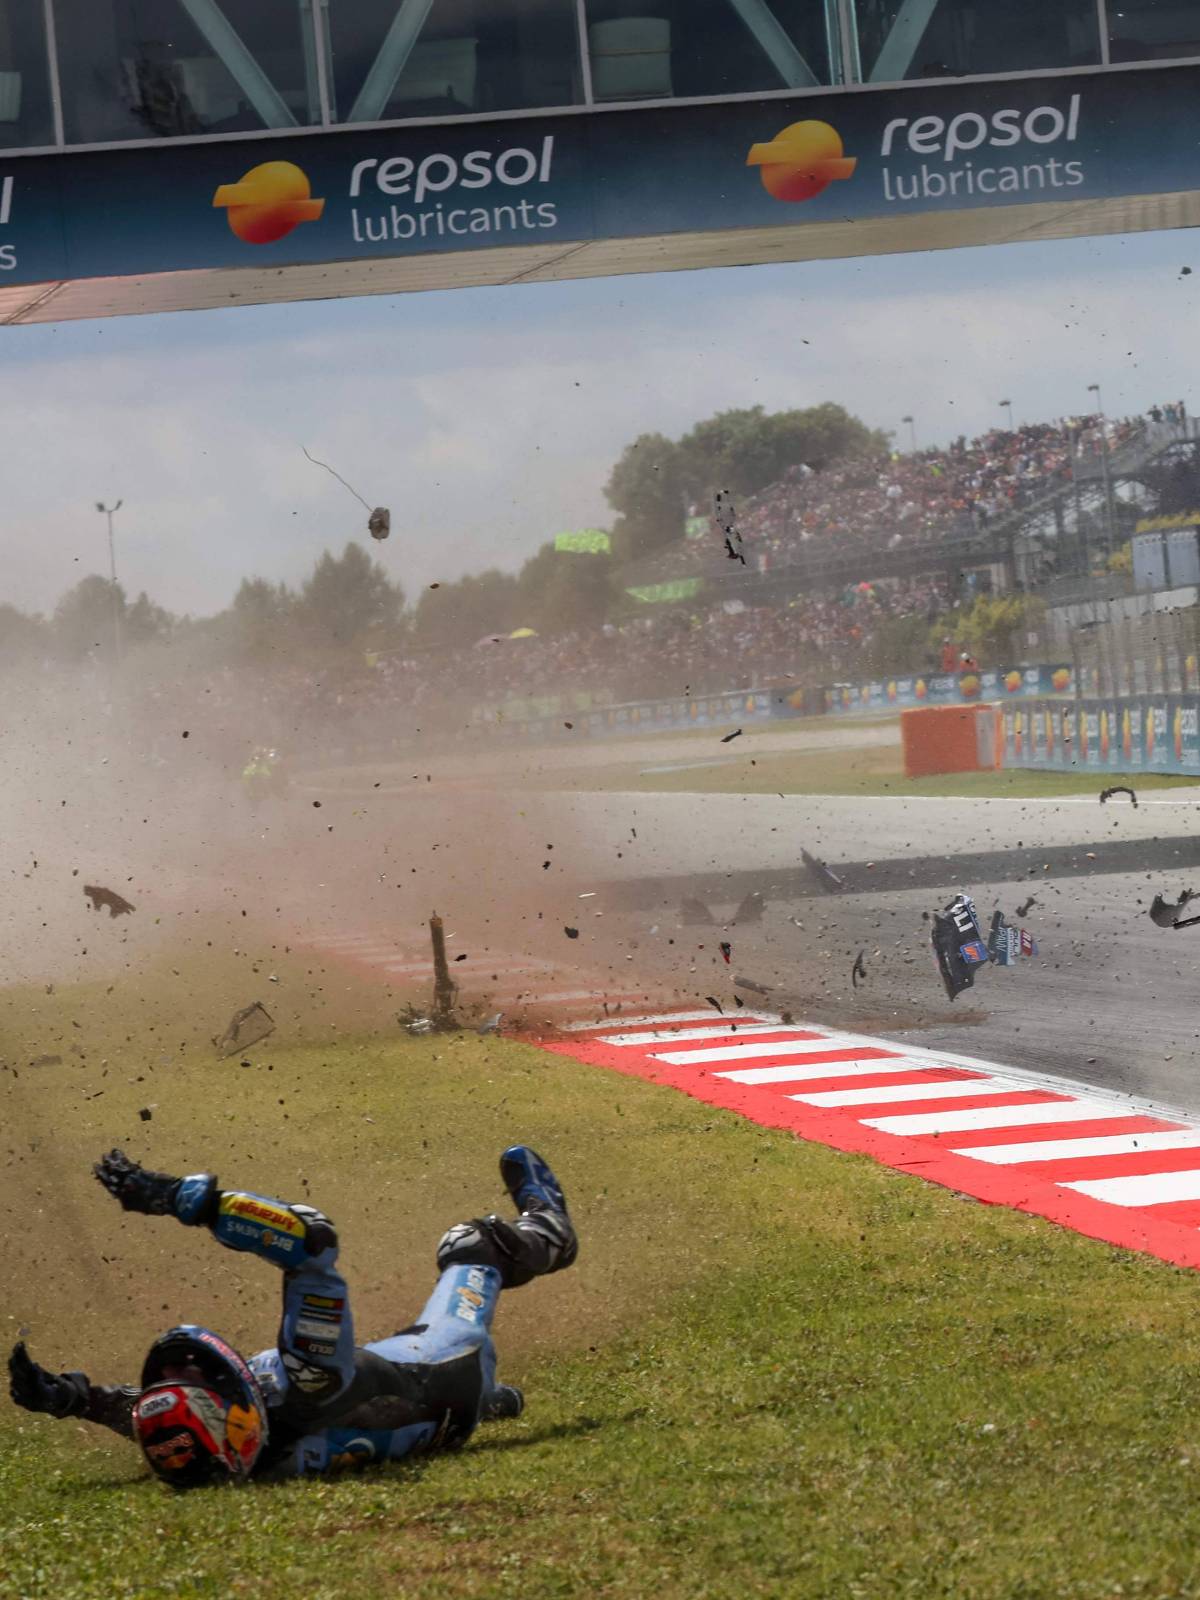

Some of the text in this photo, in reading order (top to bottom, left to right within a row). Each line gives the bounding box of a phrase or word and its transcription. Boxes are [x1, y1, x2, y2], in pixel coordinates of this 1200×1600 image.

[880, 94, 1081, 161] repsol
[350, 136, 554, 203] repsol
[882, 157, 1084, 201] lubricants
[351, 199, 557, 242] lubricants
